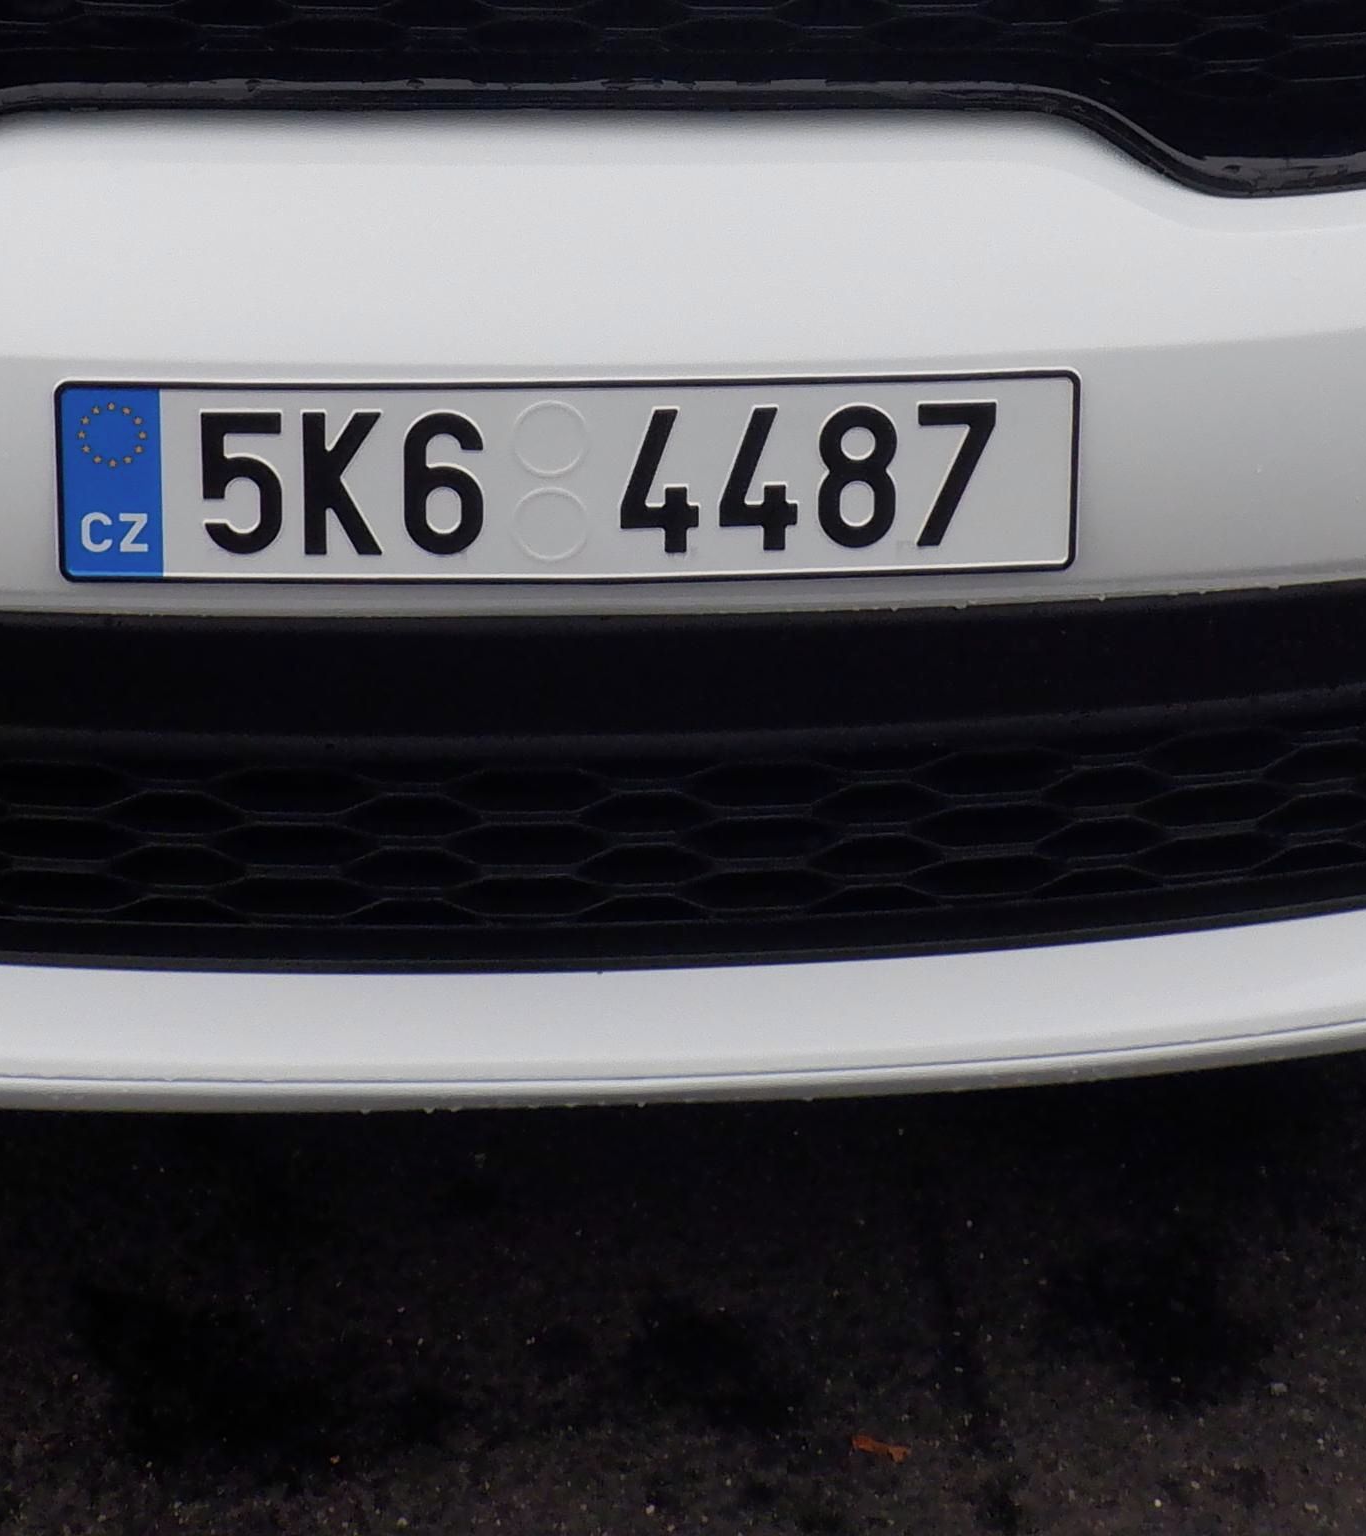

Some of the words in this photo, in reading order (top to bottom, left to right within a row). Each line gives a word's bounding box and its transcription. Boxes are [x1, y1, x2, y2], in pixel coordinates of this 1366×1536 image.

[199, 408, 486, 557] 5K6
[618, 400, 999, 555] 4487
[80, 511, 149, 554] CZ
